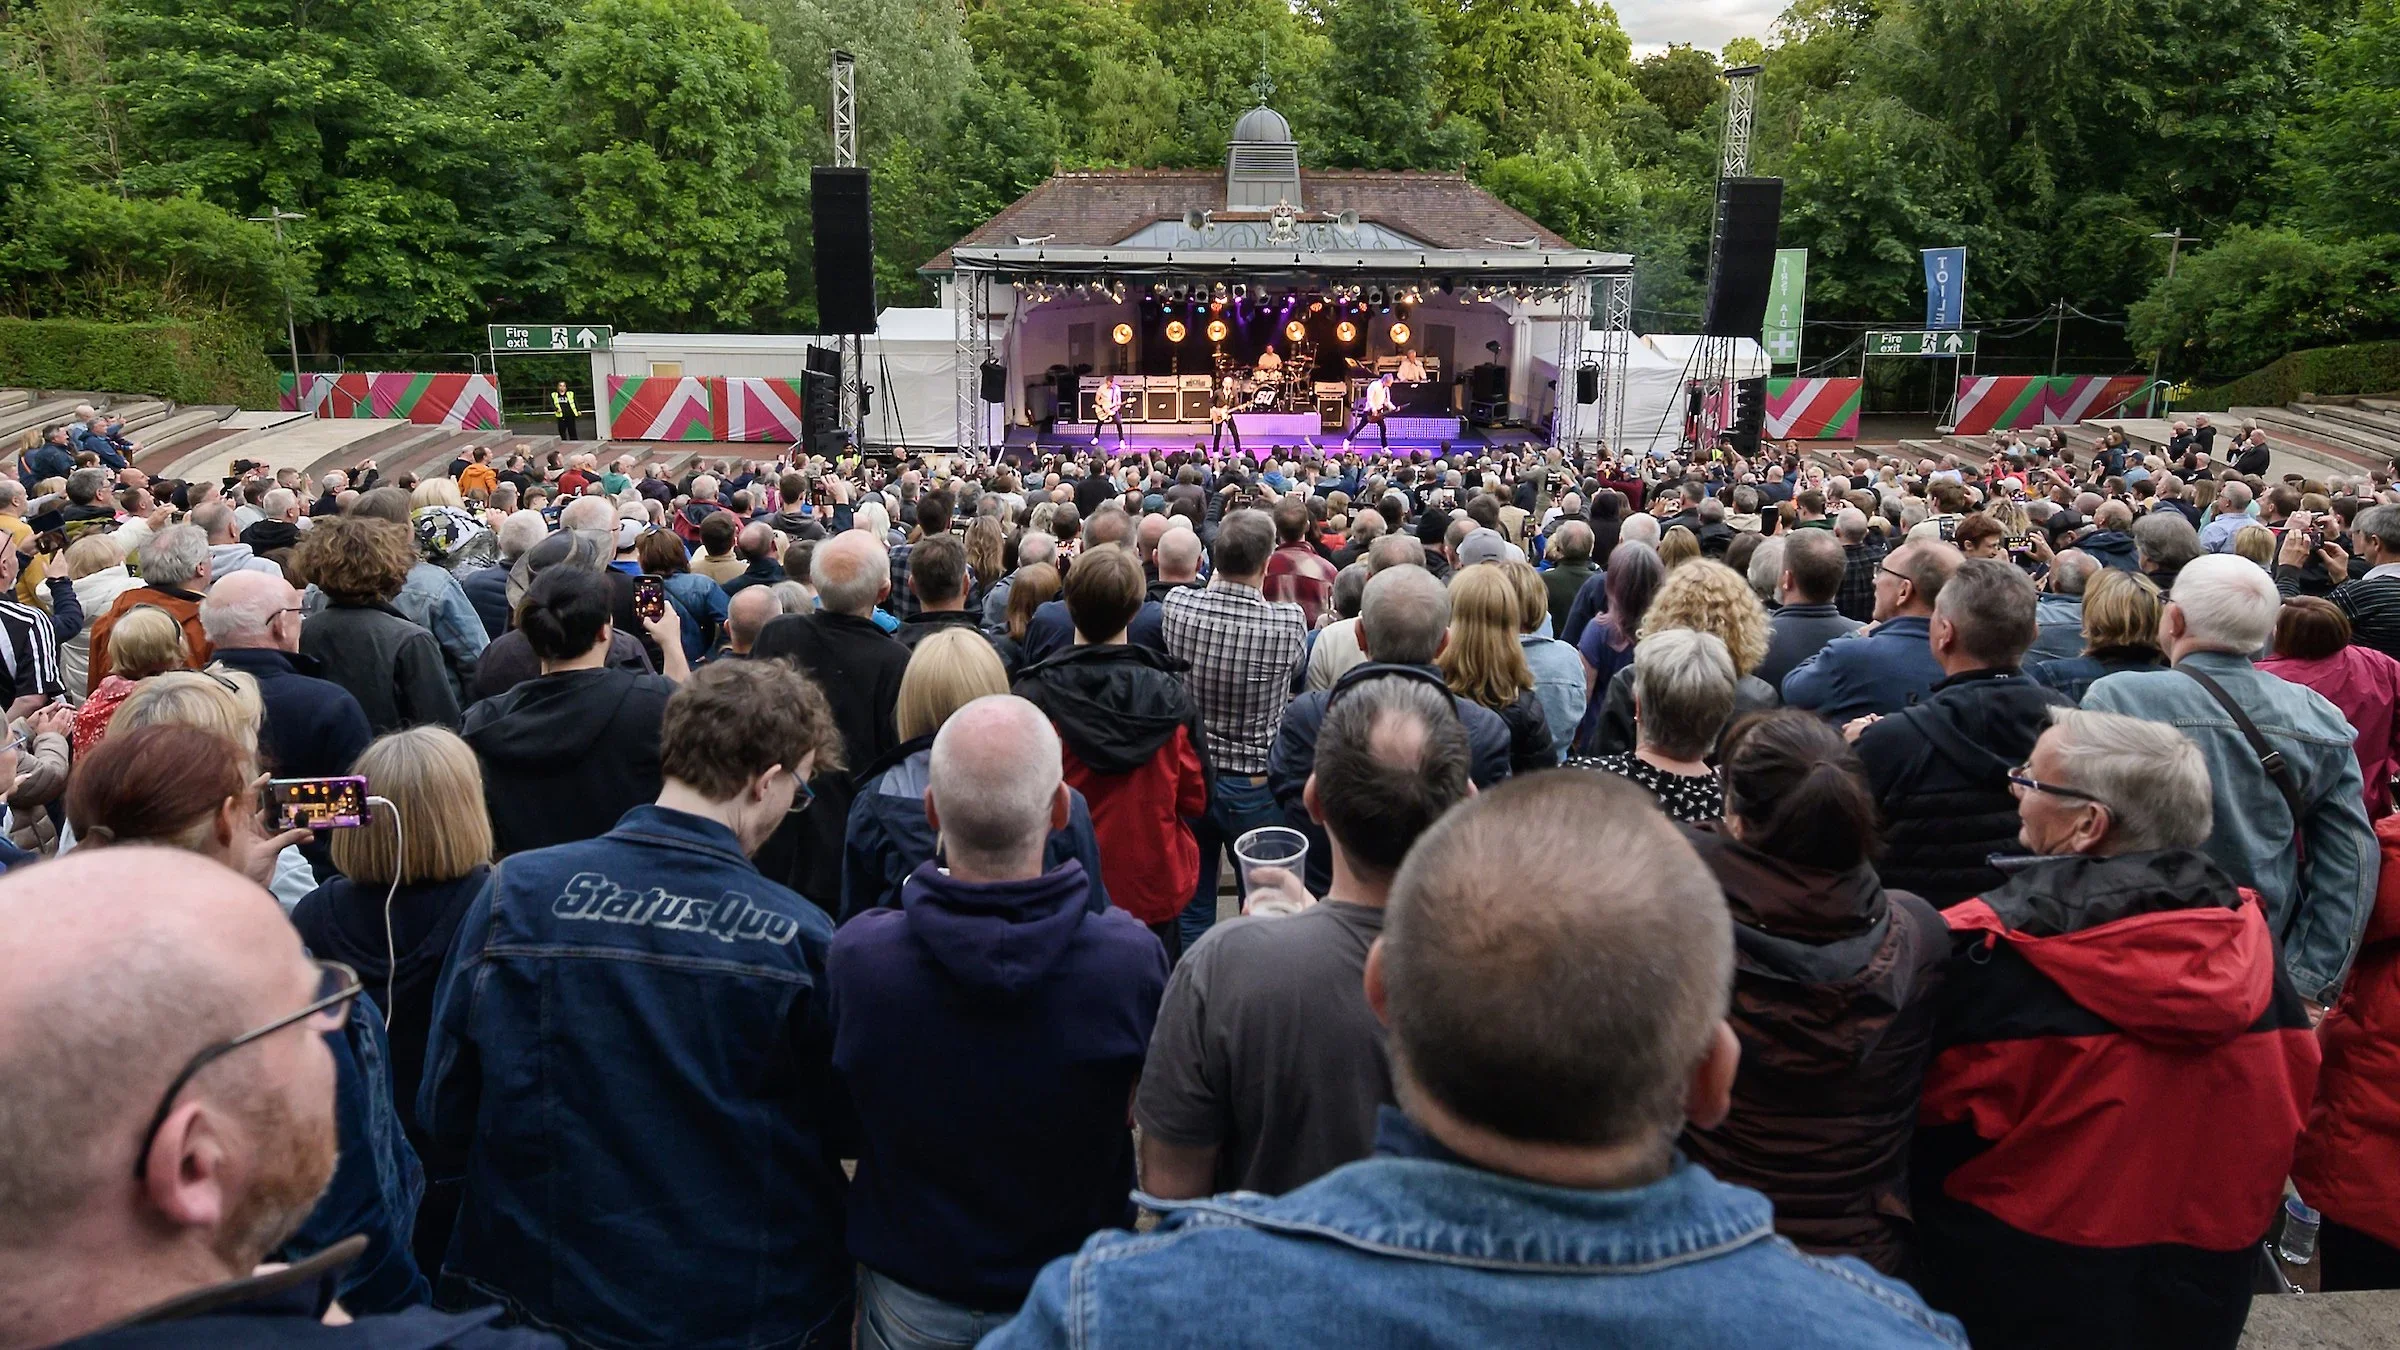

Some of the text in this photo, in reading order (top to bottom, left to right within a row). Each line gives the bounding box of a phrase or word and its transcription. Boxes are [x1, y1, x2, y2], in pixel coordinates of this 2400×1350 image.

[505, 327, 529, 338] Fire
[506, 339, 529, 348] exit
[1881, 334, 1902, 344] Fire
[1880, 344, 1901, 353] exit
